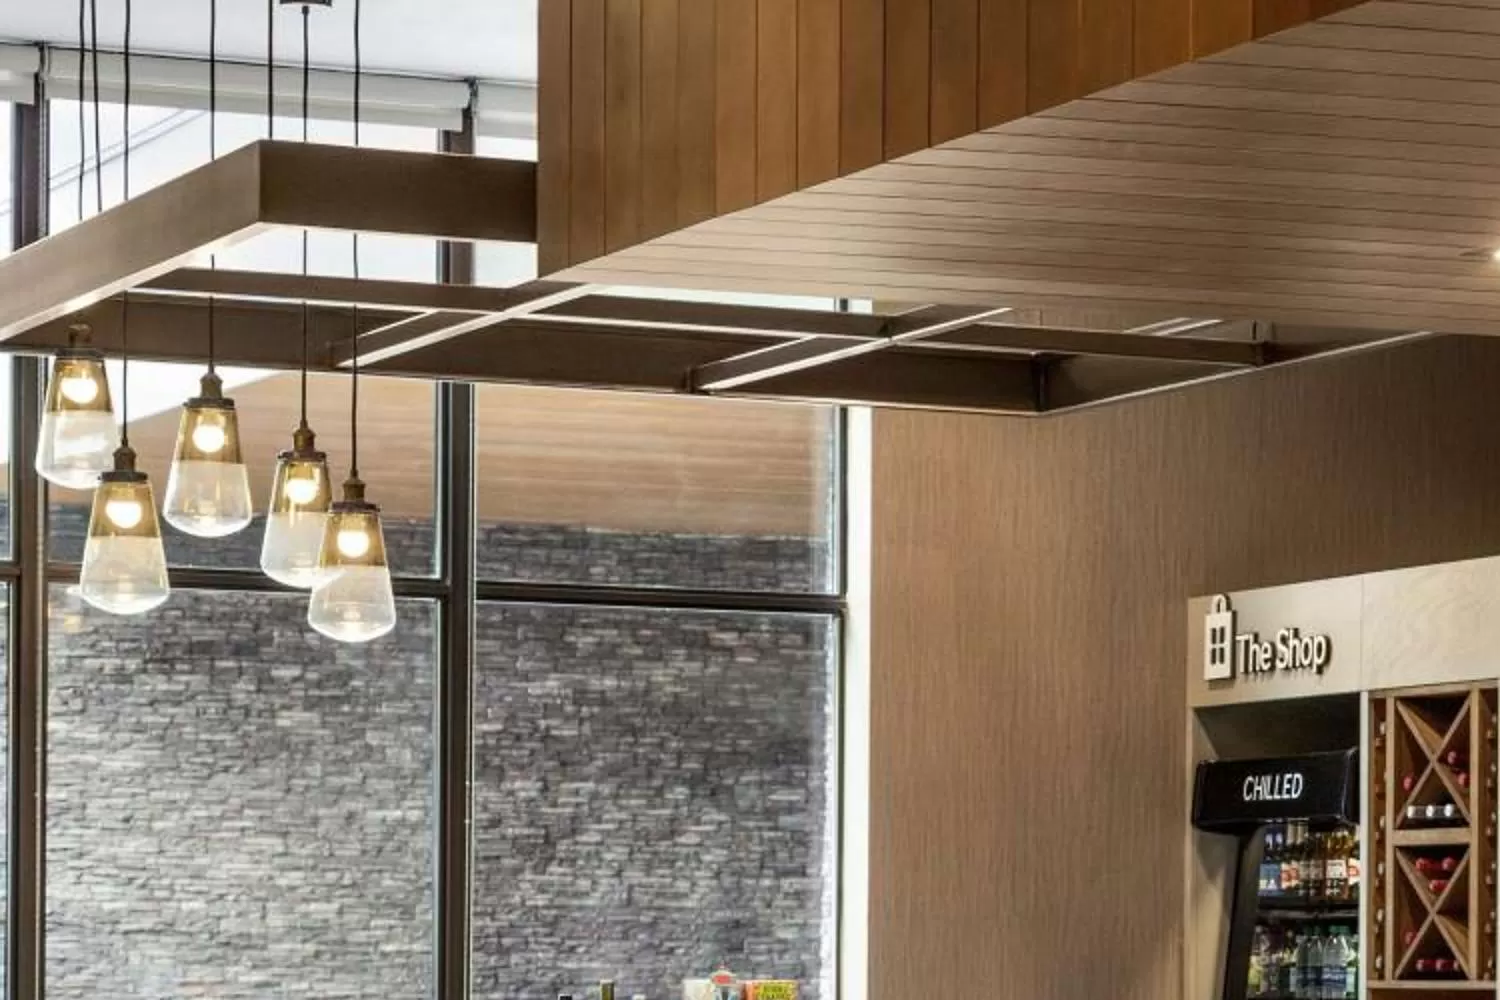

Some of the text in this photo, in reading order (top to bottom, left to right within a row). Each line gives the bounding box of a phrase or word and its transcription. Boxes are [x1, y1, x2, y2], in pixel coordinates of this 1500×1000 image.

[1235, 627, 1329, 674] The Shop
[1242, 773, 1304, 800] CHILLED
